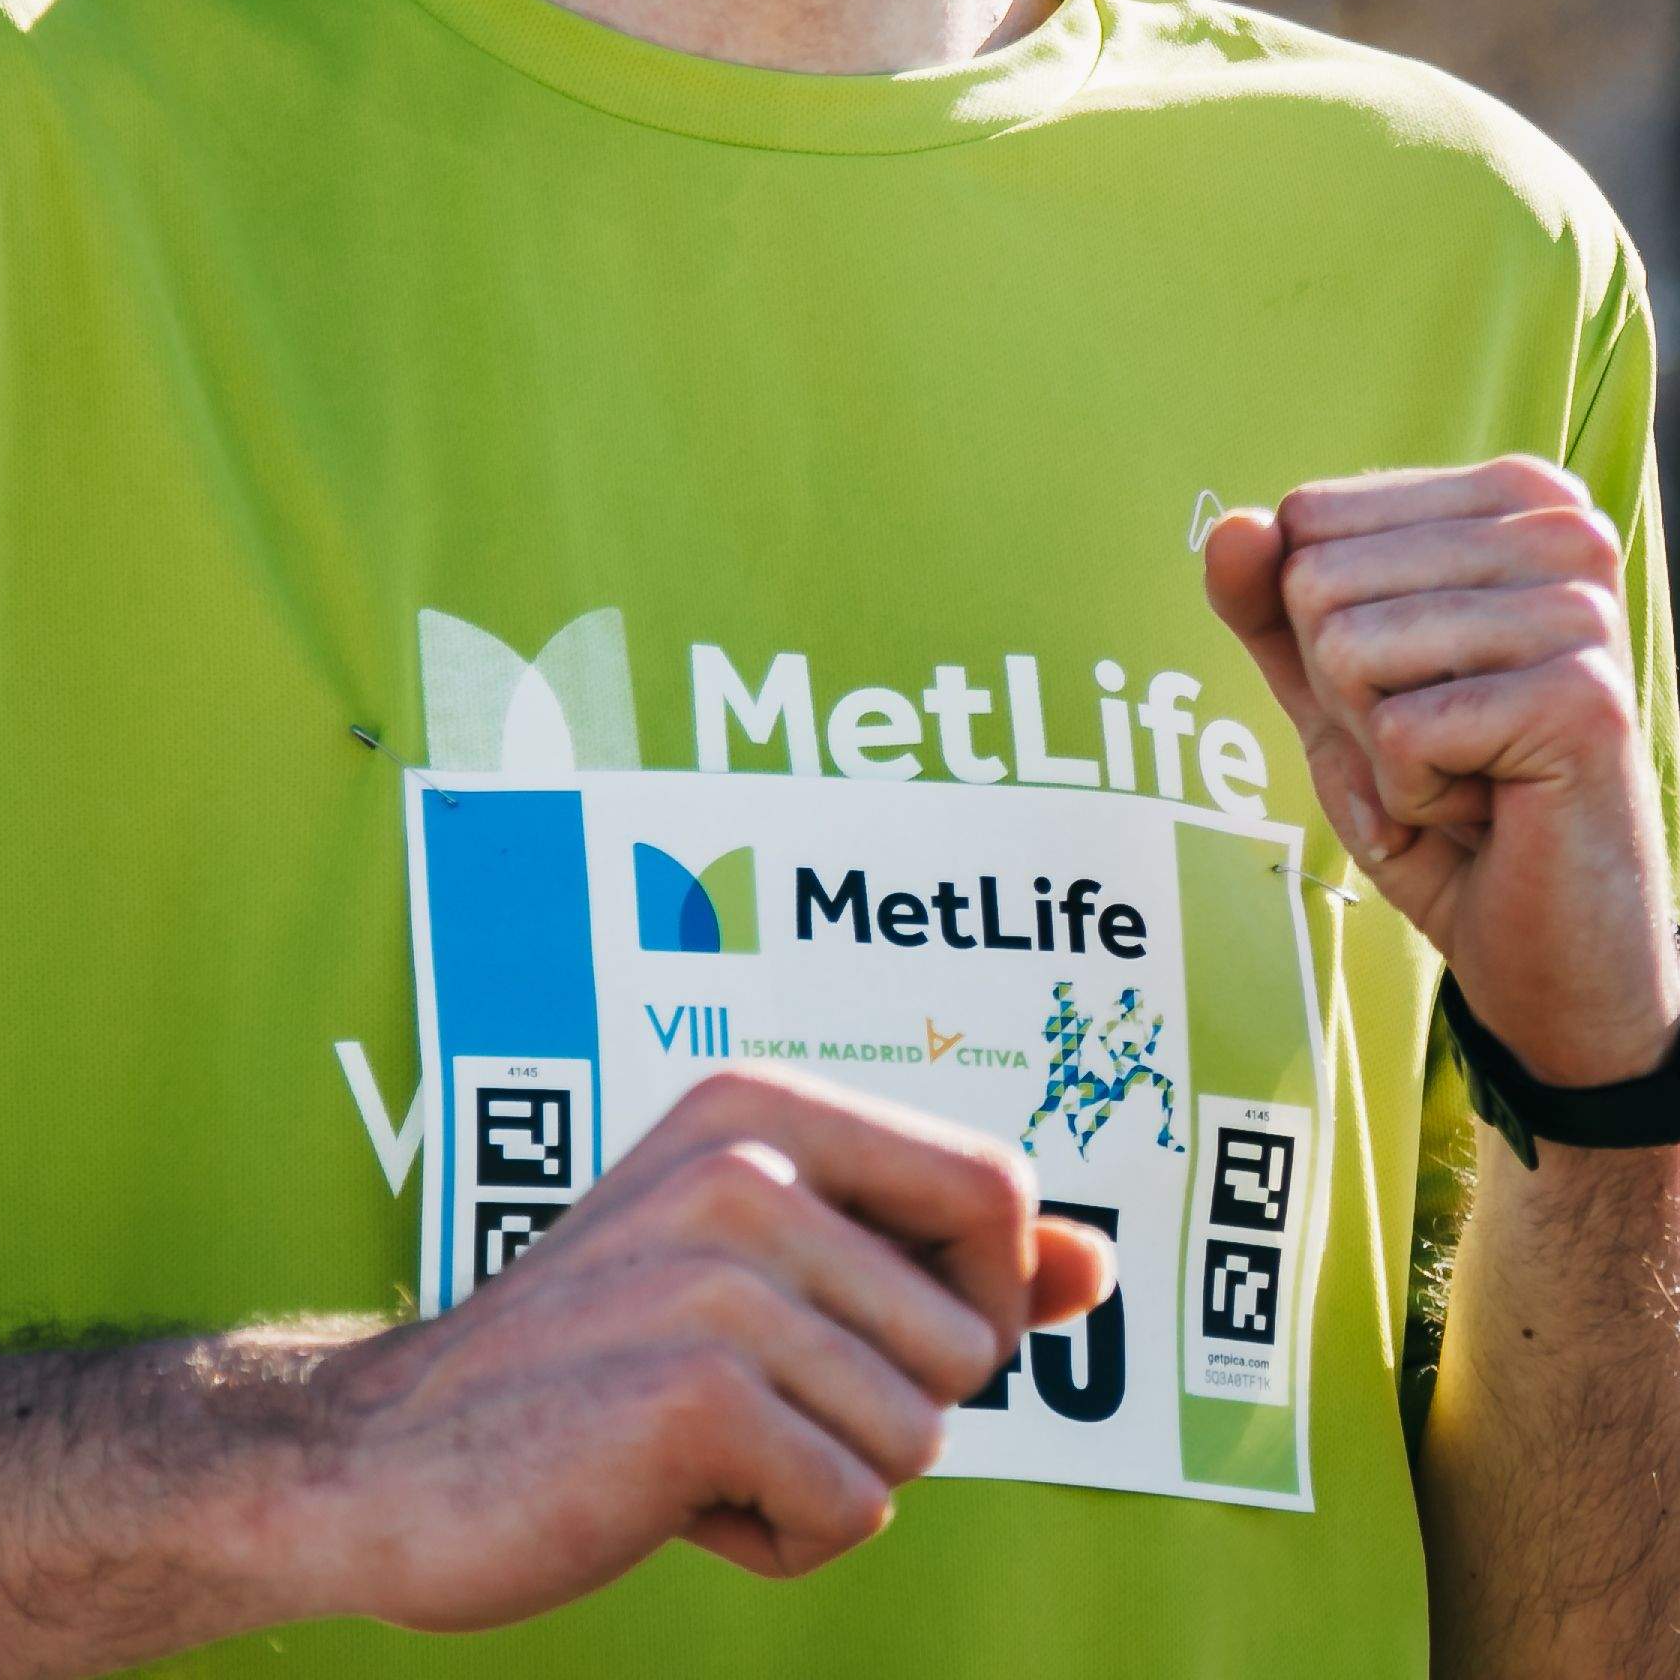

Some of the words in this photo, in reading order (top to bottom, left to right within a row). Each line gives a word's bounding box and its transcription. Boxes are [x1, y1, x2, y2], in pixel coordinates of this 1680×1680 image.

[690, 643, 1268, 820] MetLife
[795, 866, 1148, 960] MetLife
[644, 1004, 730, 1059] VIII
[740, 1038, 809, 1060] 15KM
[819, 1041, 921, 1064] MADRID
[507, 1067, 539, 1078] 4145
[1245, 1109, 1270, 1122] 4145
[1207, 1352, 1270, 1371] getpica.com
